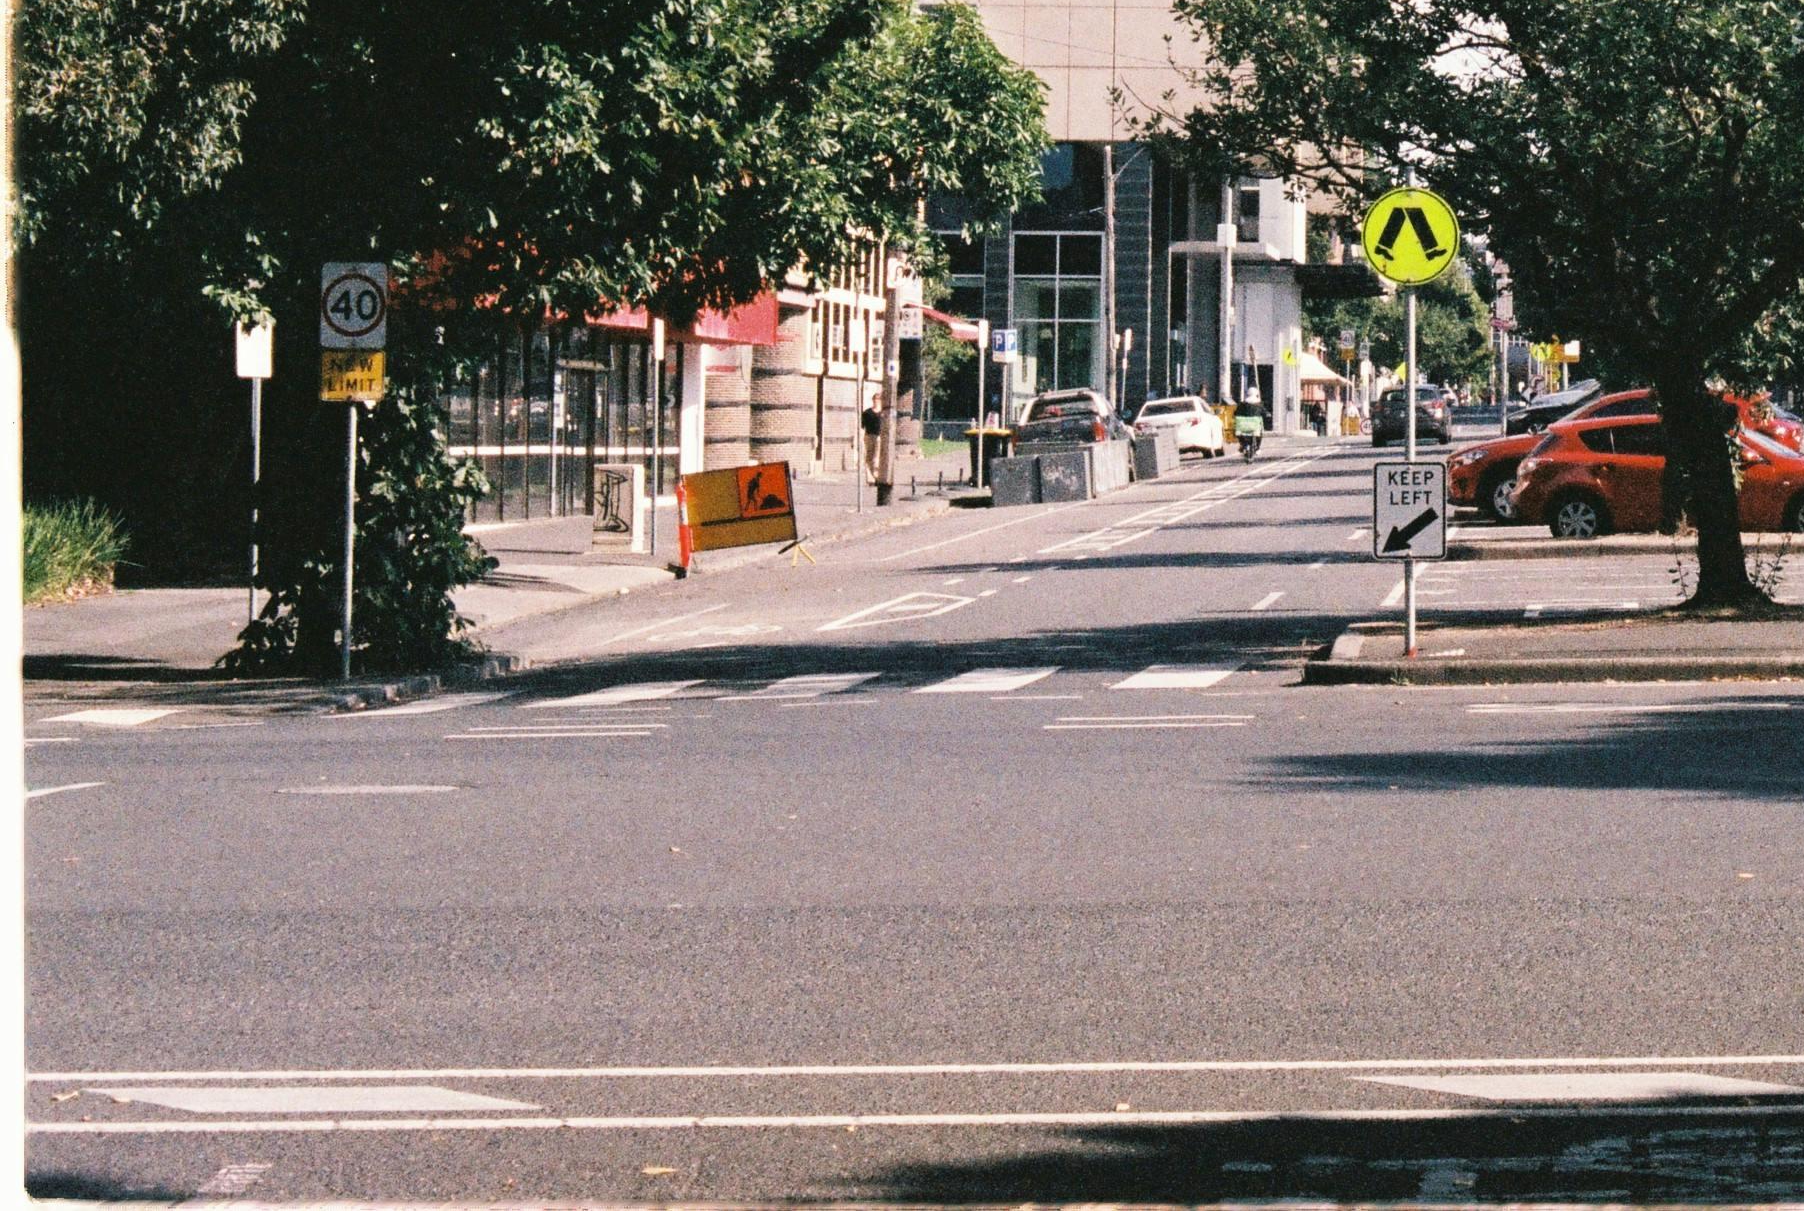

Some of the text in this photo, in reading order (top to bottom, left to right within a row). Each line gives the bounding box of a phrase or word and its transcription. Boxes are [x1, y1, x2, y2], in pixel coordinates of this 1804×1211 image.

[331, 290, 378, 320] 40
[996, 334, 1003, 349] P
[1008, 334, 1014, 350] P
[329, 358, 373, 372] NEW
[328, 378, 376, 392] LIMIT
[1388, 471, 1434, 485] KEEP
[1389, 491, 1432, 505] LEFT
